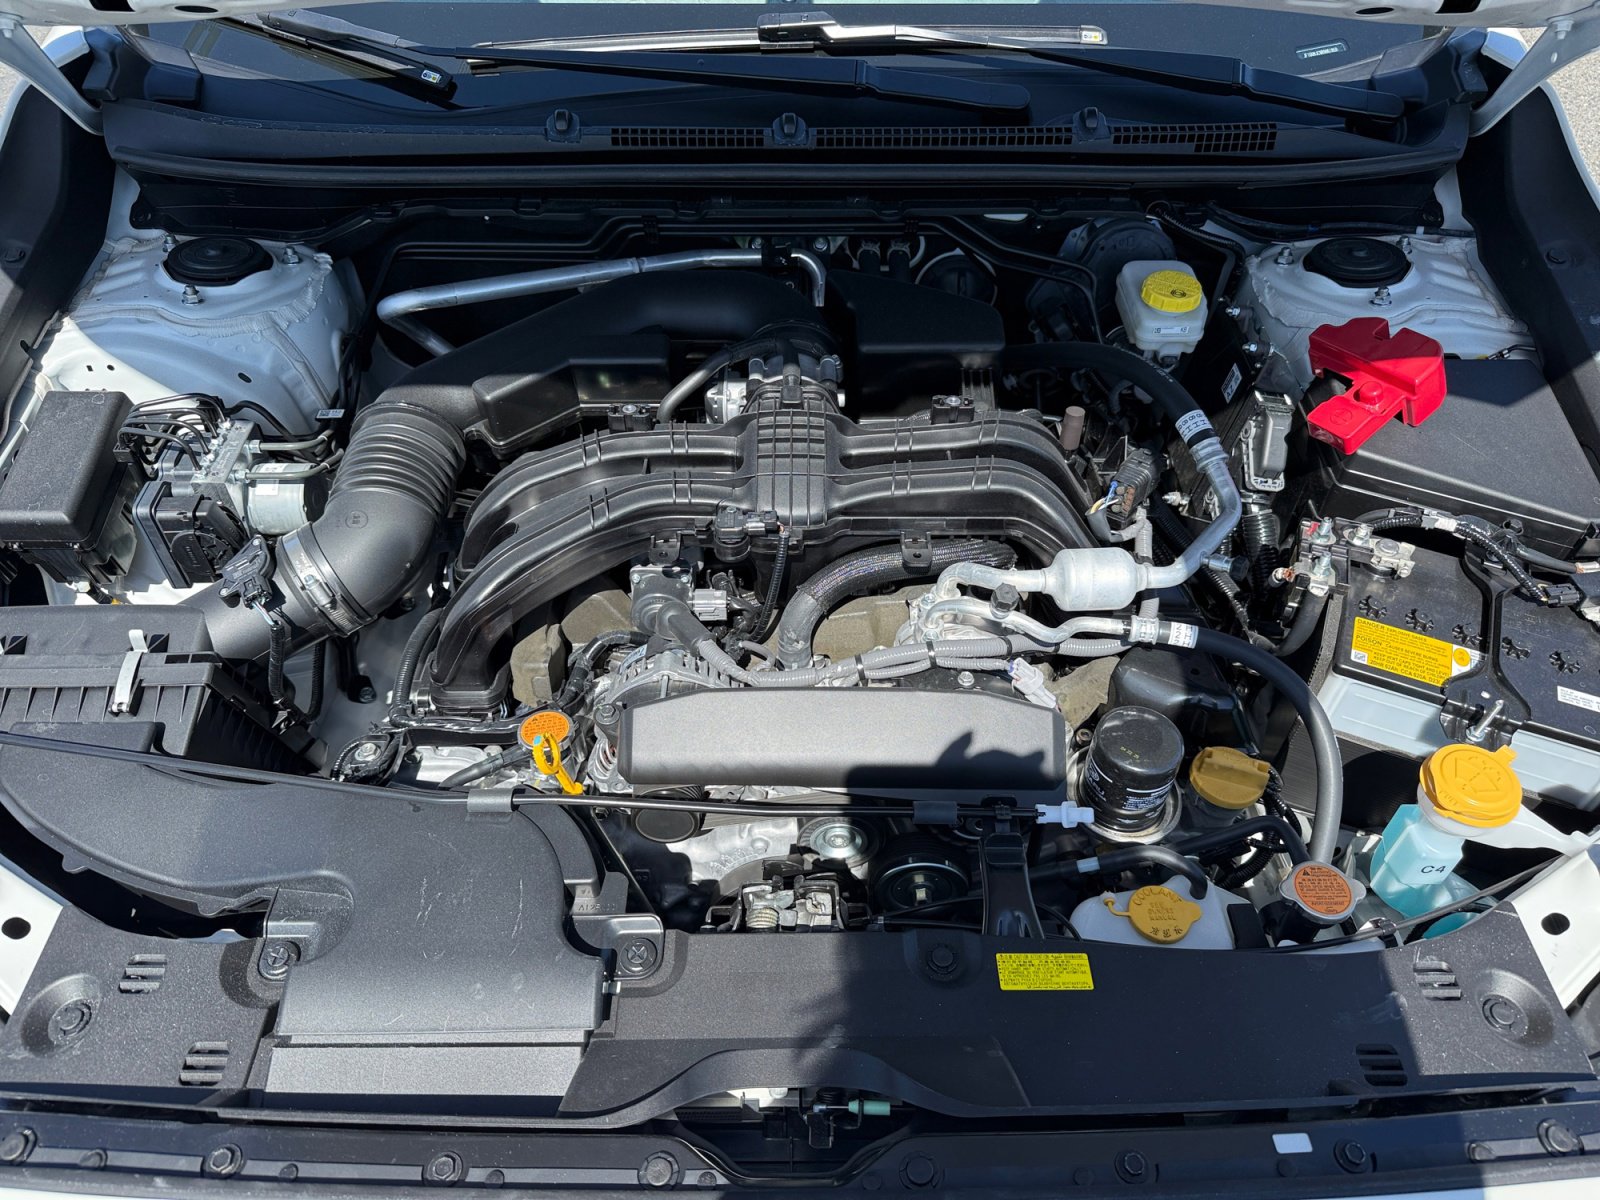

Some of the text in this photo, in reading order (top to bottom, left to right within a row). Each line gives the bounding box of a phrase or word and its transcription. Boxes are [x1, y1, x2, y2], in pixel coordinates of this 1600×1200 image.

[1357, 619, 1384, 630] DANGER
[1356, 634, 1382, 646] POISON
[1420, 865, 1447, 874] C4
[1132, 887, 1183, 906] COOLANT
